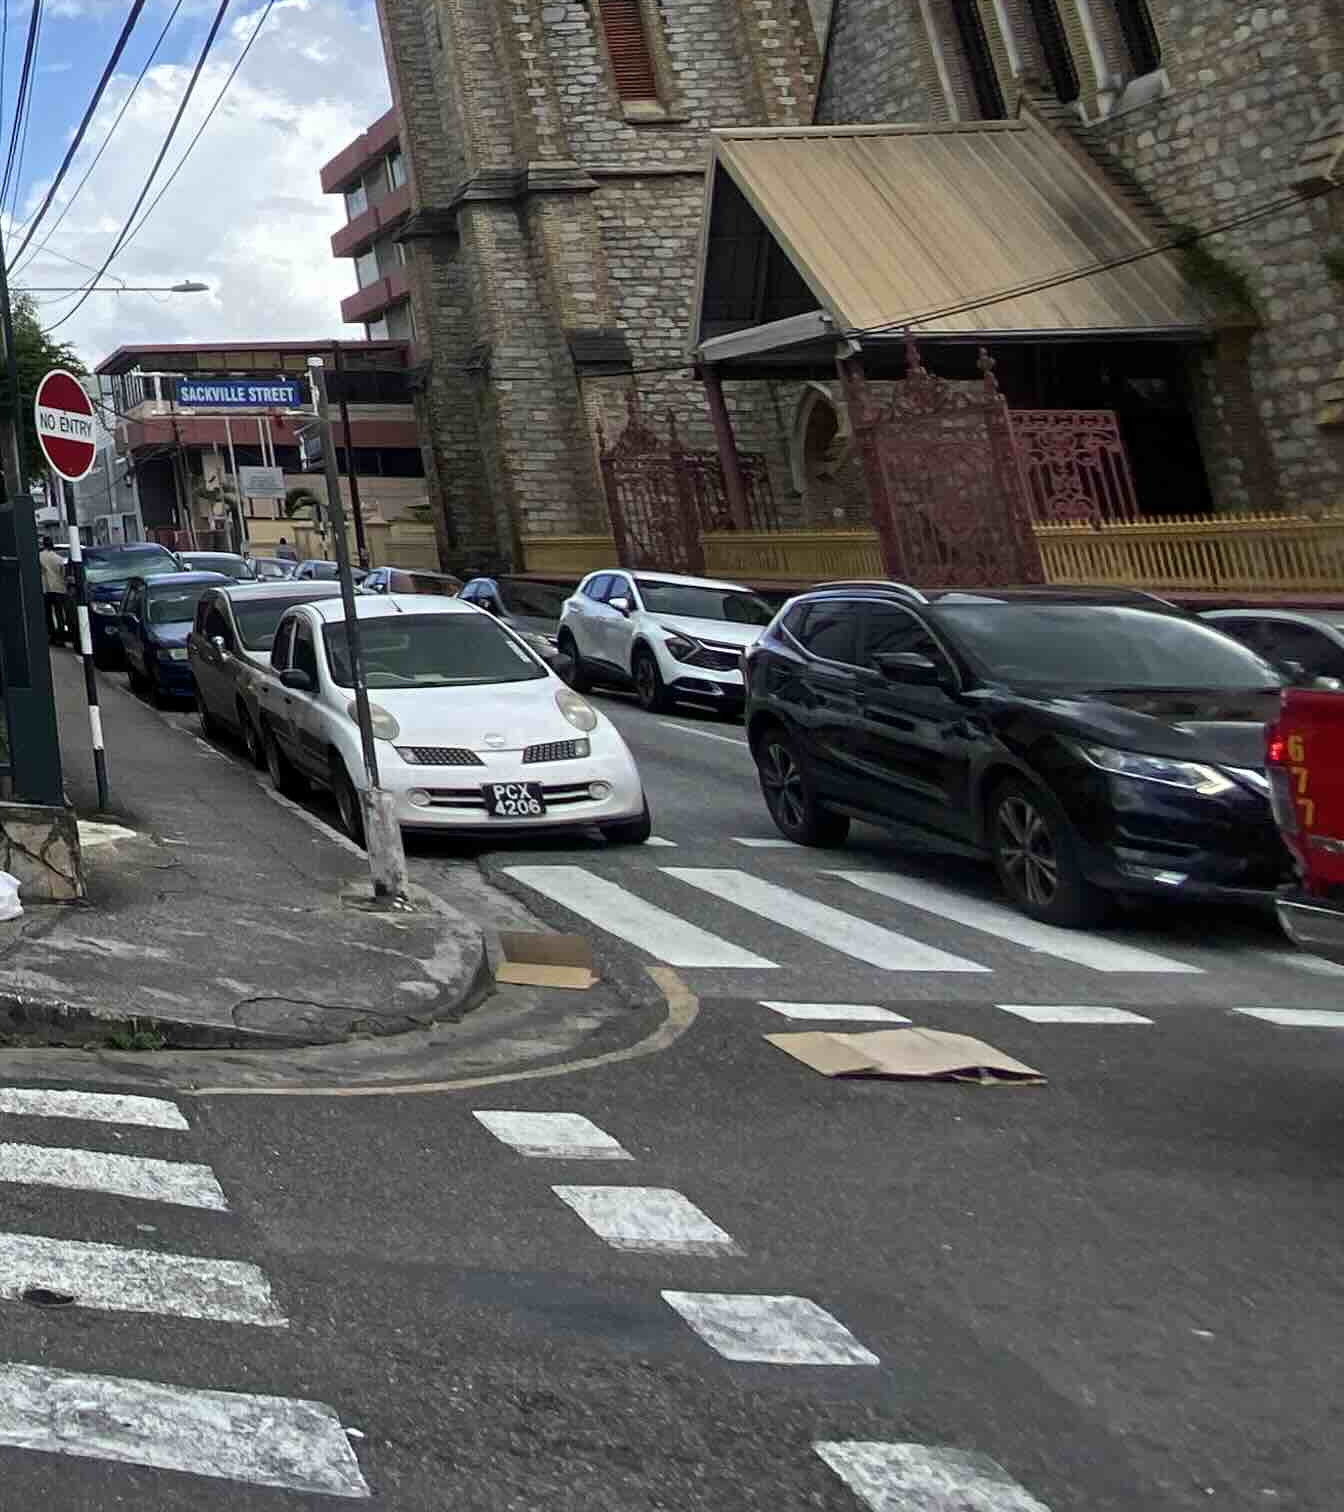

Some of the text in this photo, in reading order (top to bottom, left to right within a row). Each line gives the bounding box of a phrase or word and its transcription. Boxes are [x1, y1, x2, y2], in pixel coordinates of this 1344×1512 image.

[180, 386, 295, 402] SACKVILLE STREET
[40, 412, 93, 437] NO ENTRY
[492, 784, 532, 800] PCX
[495, 799, 542, 816] 4206
